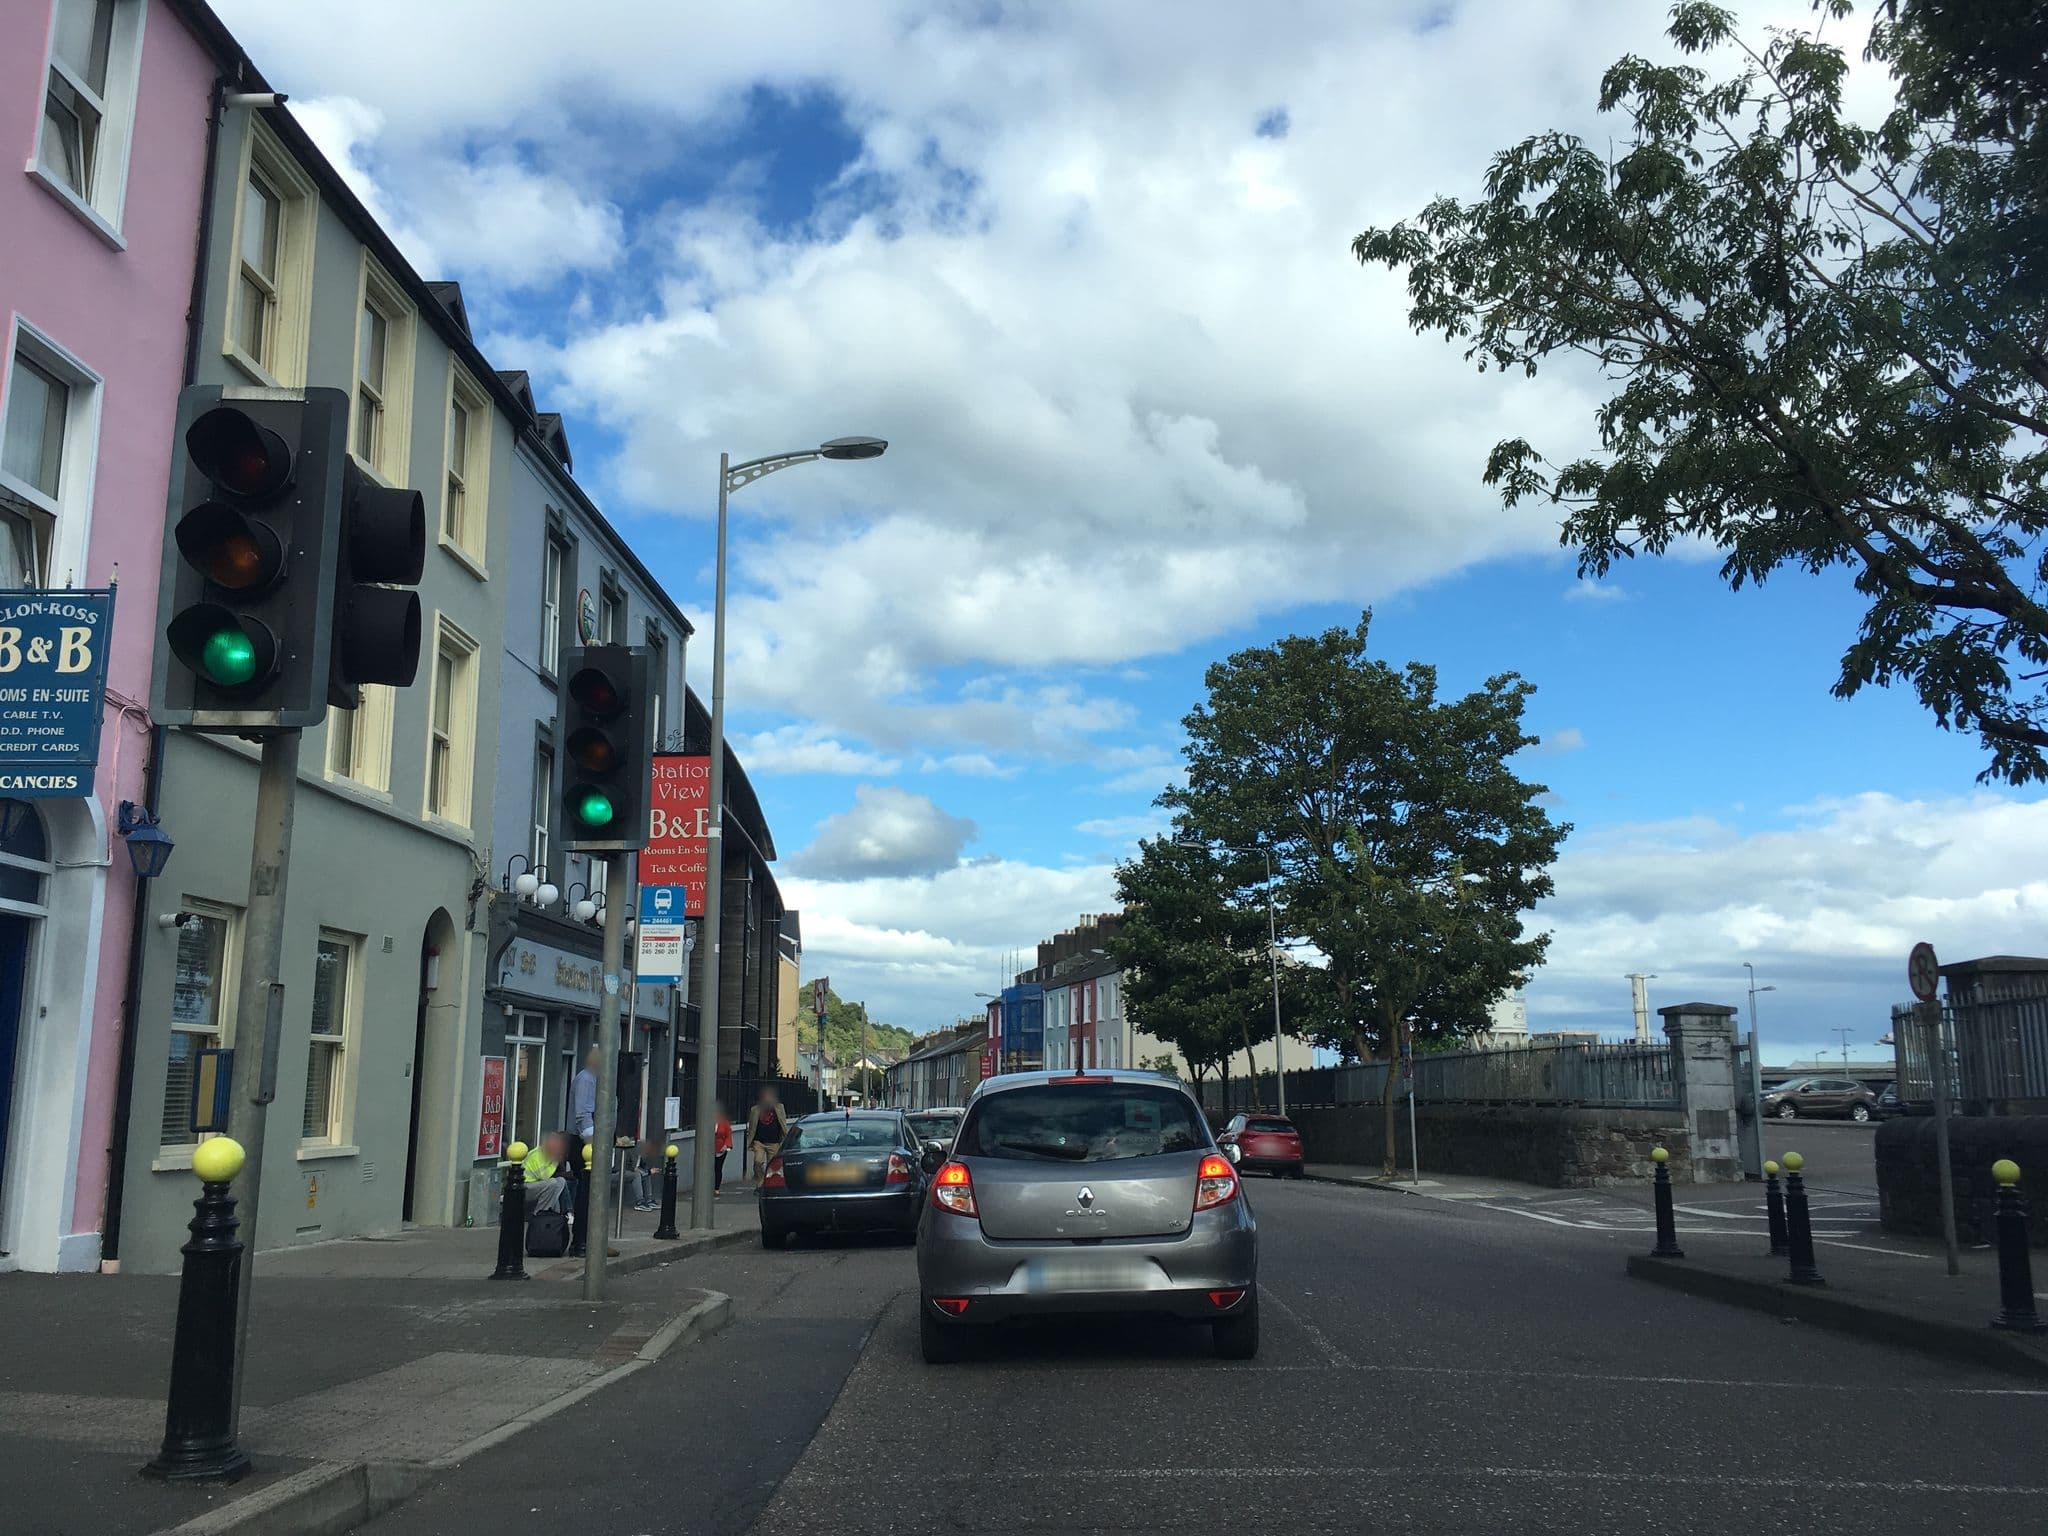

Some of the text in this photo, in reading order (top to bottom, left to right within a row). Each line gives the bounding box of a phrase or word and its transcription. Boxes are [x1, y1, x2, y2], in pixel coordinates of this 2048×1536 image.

[32, 689, 90, 703] EN-SUITE
[3, 711, 63, 719] CABLE T.V.
[27, 727, 65, 735] PHONE
[0, 743, 80, 752] CREDIT CARDS
[658, 782, 705, 800] View
[644, 845, 708, 855] Rooms En-Su
[650, 864, 666, 873] Tea
[668, 864, 677, 873] &
